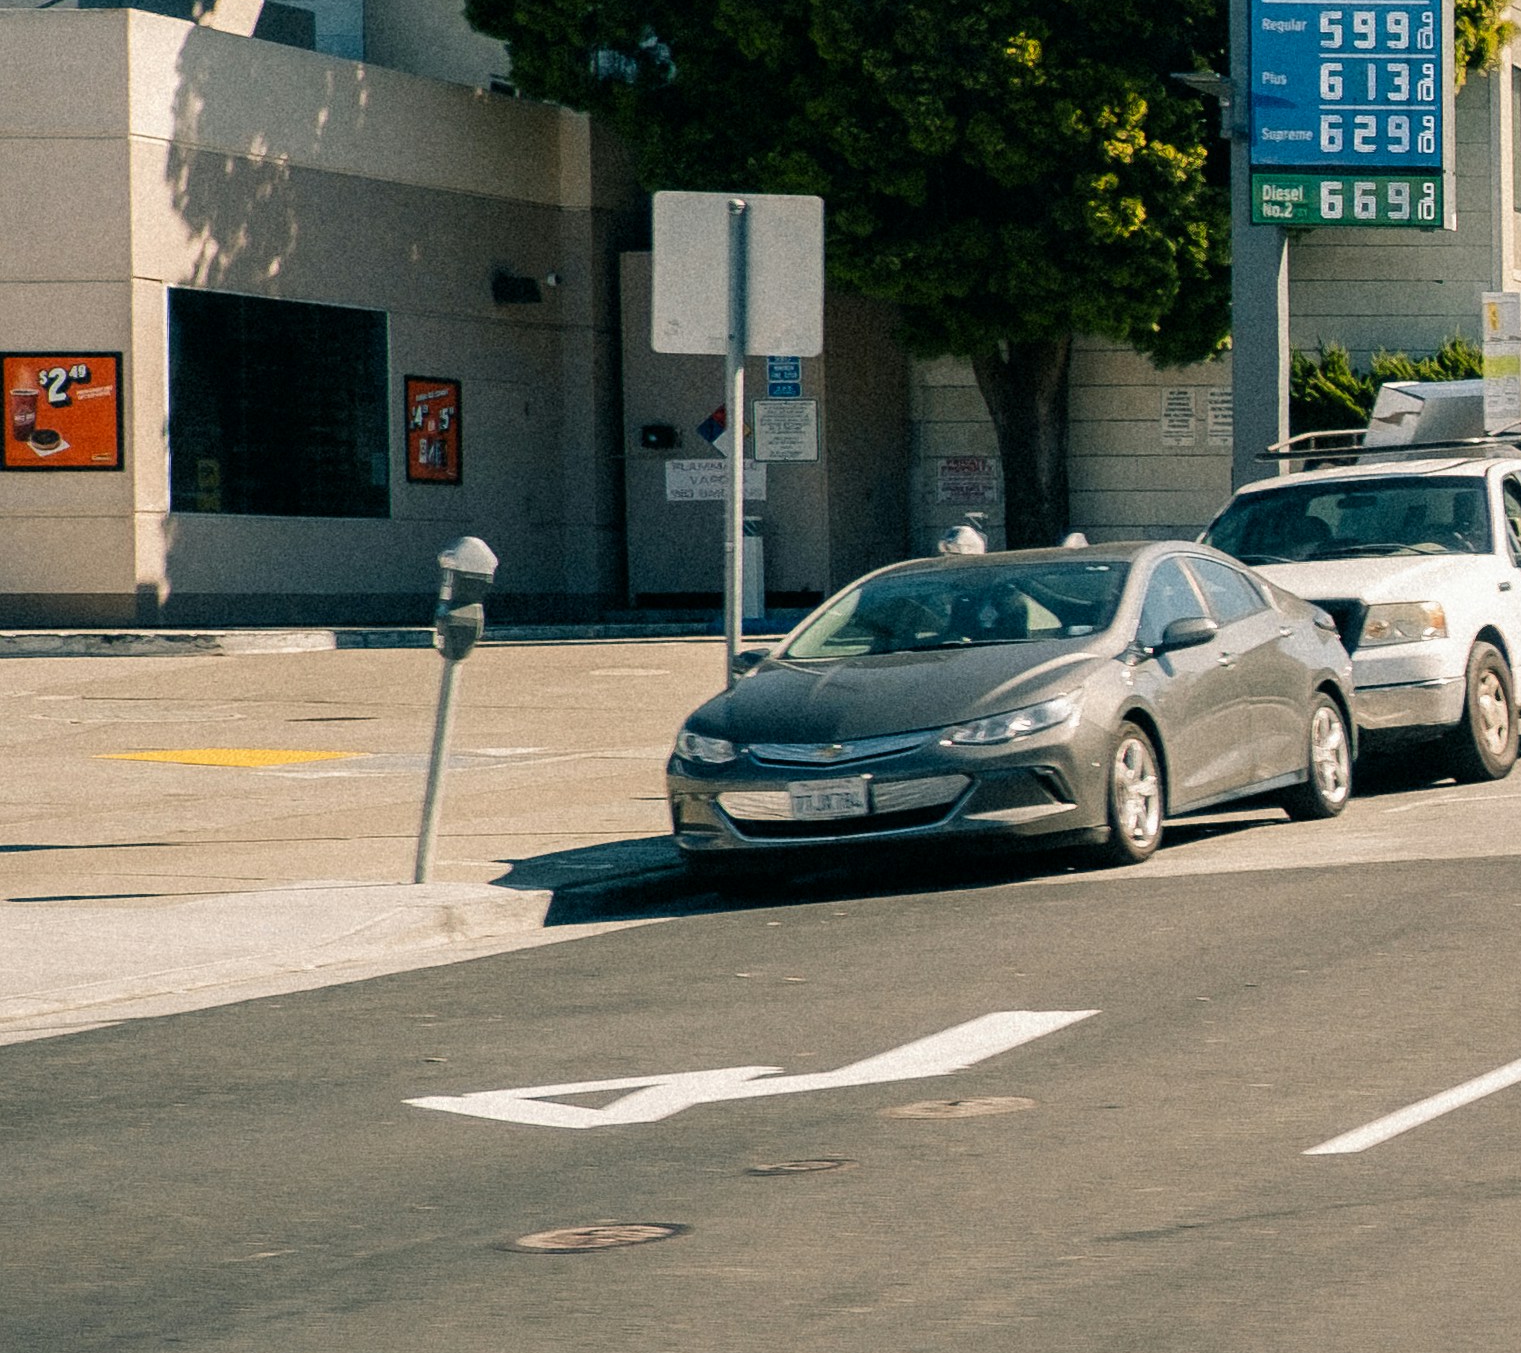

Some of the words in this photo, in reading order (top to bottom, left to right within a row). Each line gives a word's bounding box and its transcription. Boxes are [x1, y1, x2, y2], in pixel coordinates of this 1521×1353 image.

[1261, 18, 1307, 33] Regular
[1319, 11, 1410, 49] 599
[1262, 71, 1288, 85] Plus
[1319, 63, 1410, 101] 613
[1261, 127, 1314, 143] Supreme
[1319, 115, 1410, 153] 629
[1262, 184, 1304, 201] Diesel
[1320, 181, 1411, 220] 669
[1262, 202, 1294, 219] No.2
